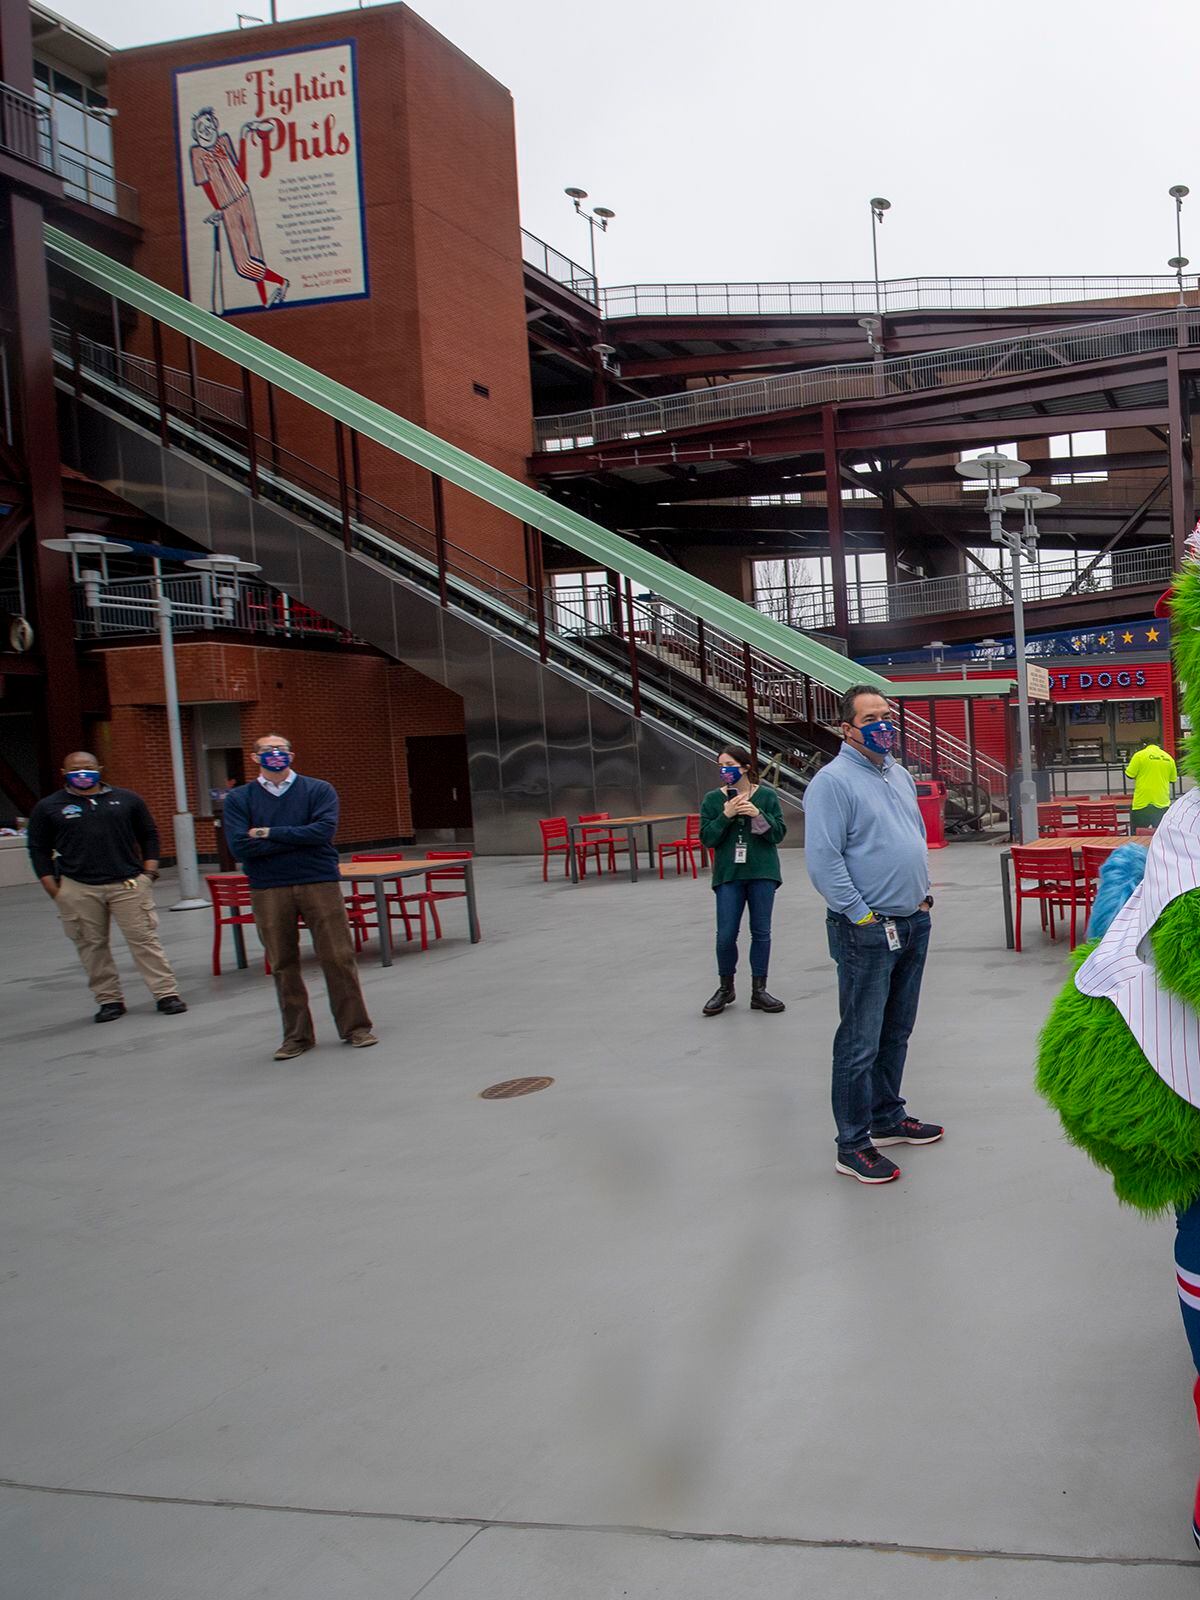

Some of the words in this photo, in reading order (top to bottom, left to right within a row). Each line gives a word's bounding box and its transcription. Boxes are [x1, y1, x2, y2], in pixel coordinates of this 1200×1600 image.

[225, 88, 247, 107] THE
[245, 64, 347, 118] Fightin'
[250, 113, 350, 179] Phils
[1080, 671, 1146, 688] DOGS
